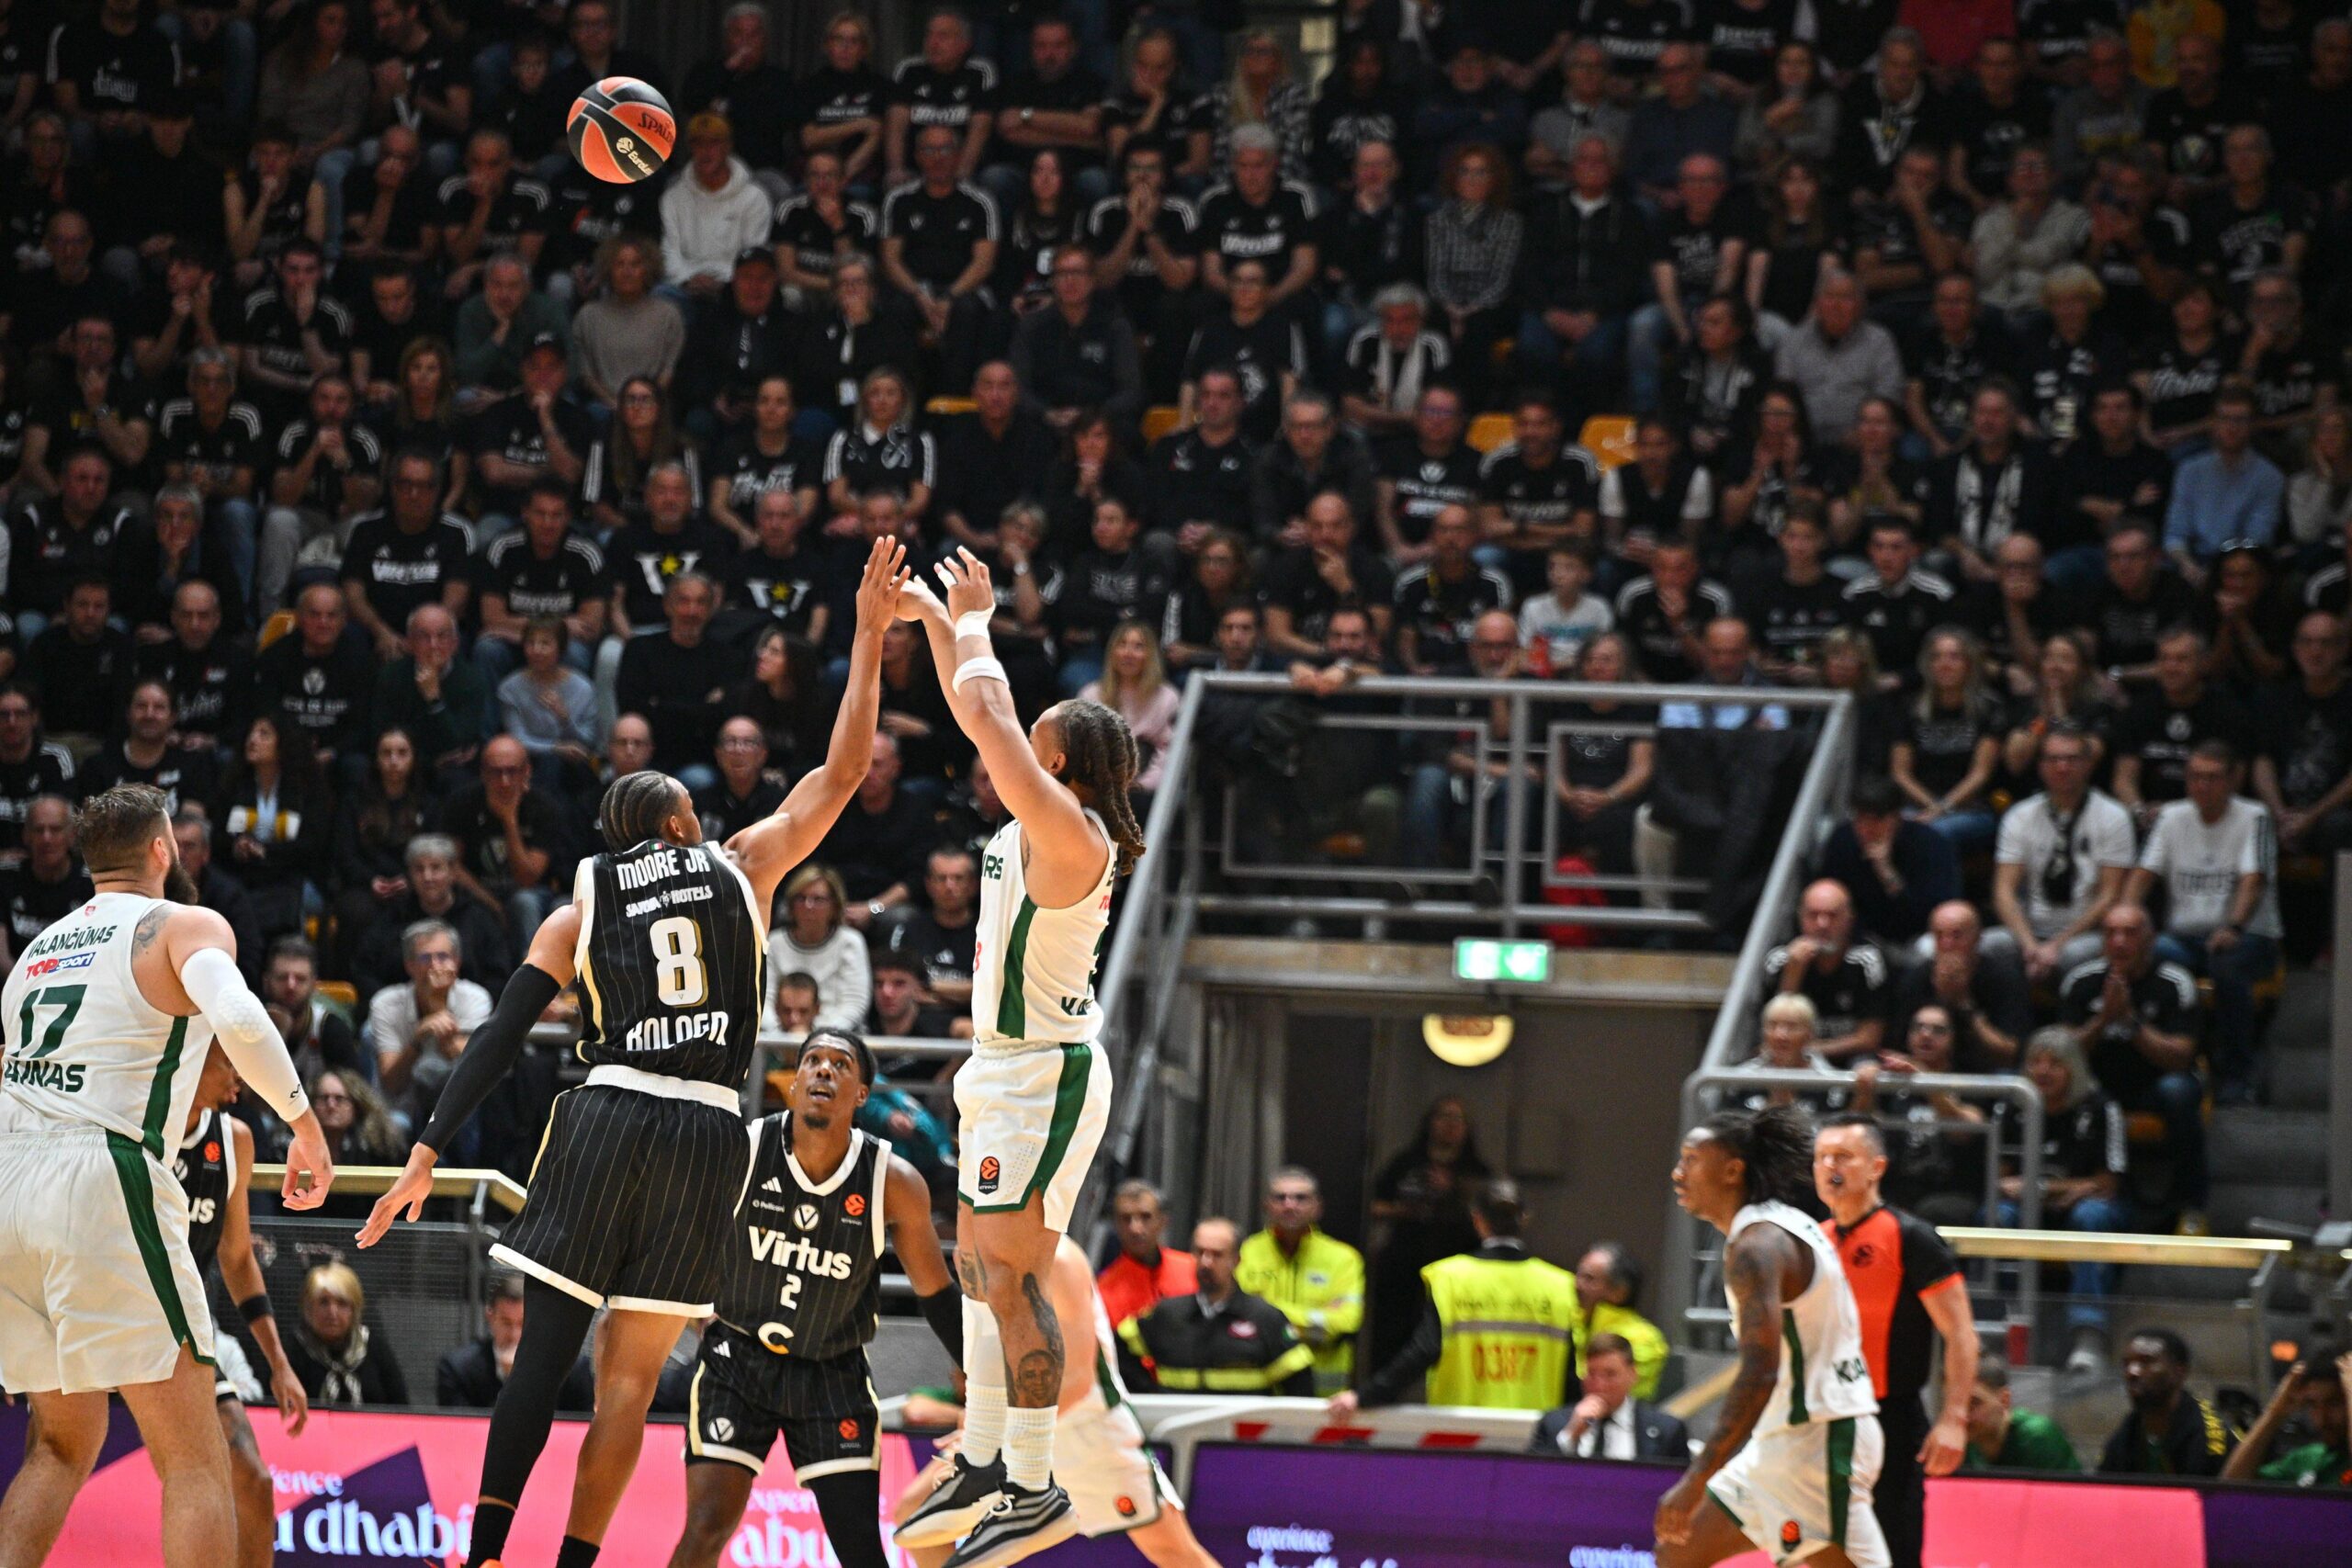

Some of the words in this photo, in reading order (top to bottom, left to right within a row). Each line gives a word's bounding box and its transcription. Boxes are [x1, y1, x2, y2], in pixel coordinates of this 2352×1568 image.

[616, 849, 681, 891] MOORE
[684, 847, 711, 873] JR
[671, 885, 713, 905] HOTELS
[650, 916, 709, 1009] 8
[10, 984, 88, 1059] 17
[748, 1225, 853, 1280] Virtus
[780, 1273, 802, 1311] 2
